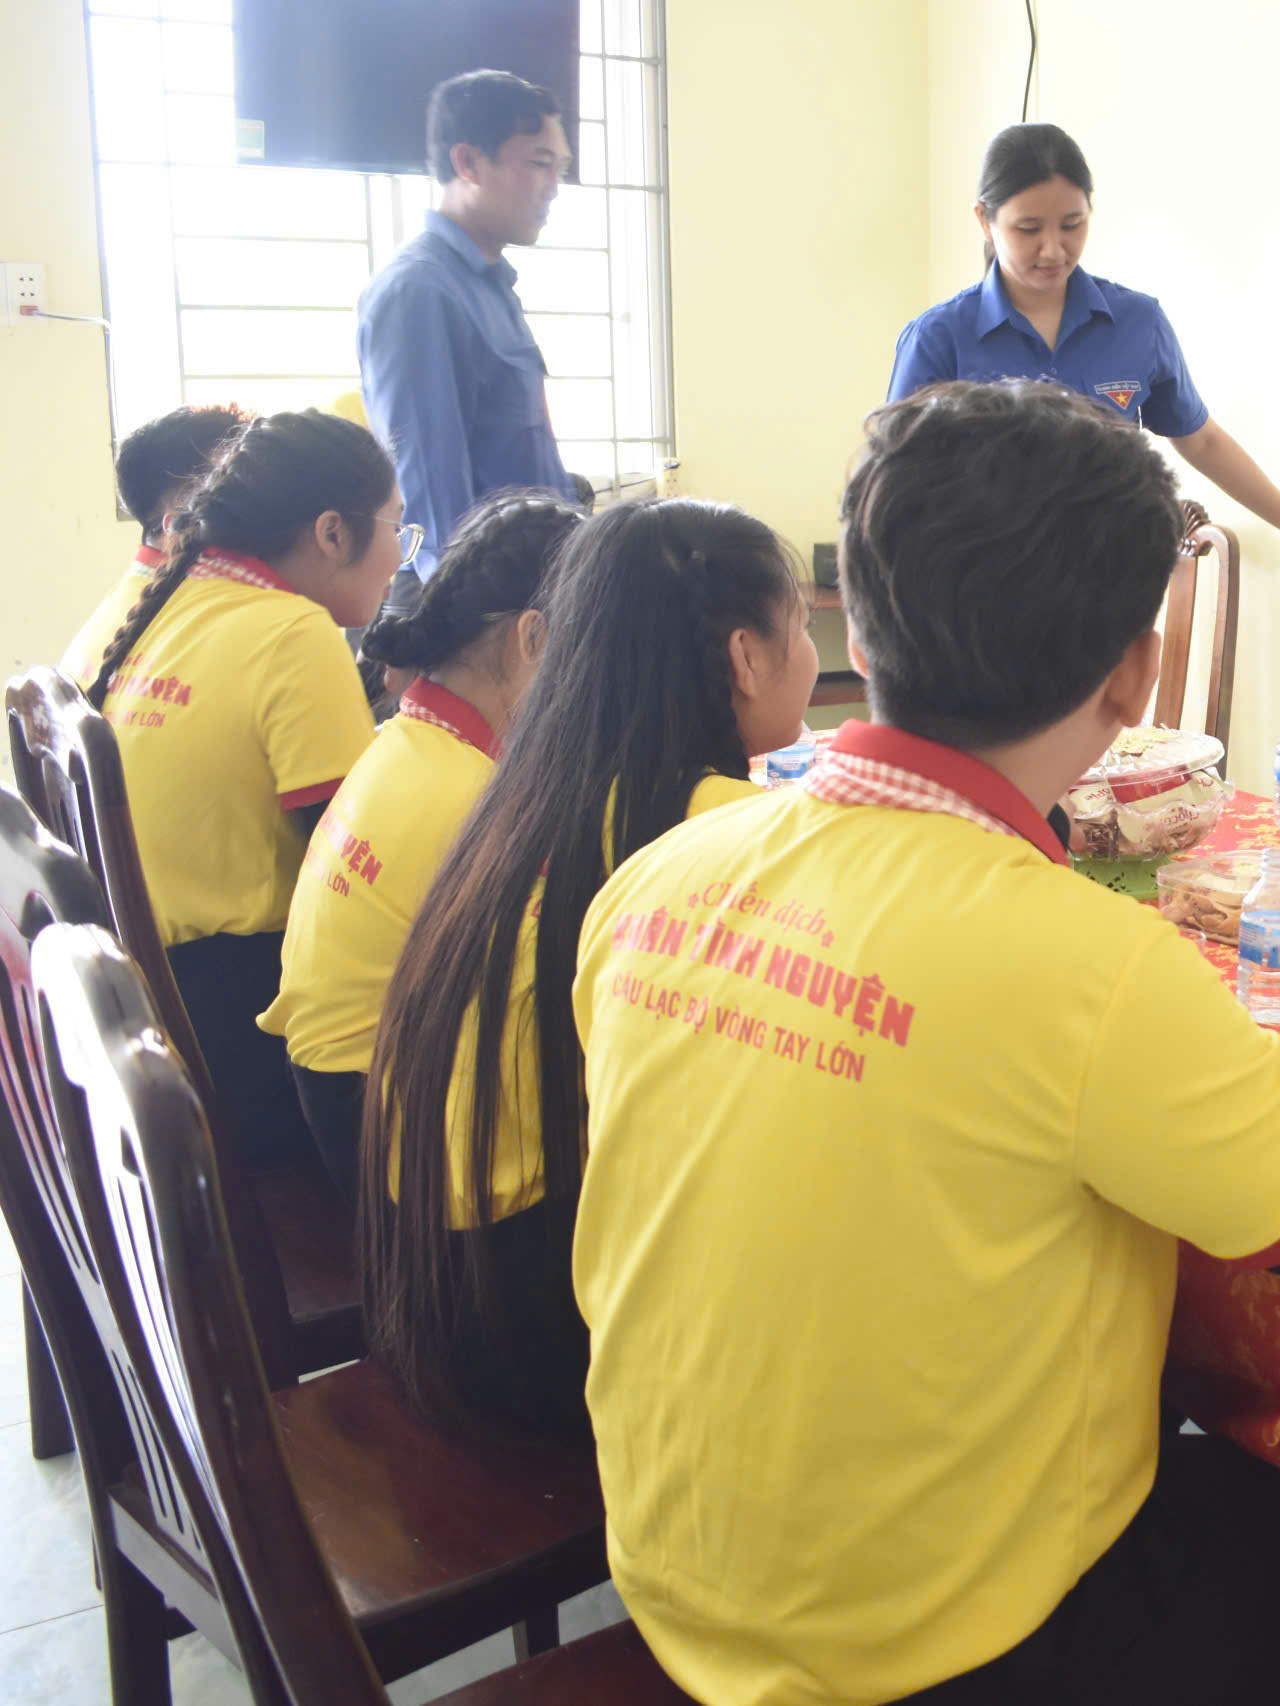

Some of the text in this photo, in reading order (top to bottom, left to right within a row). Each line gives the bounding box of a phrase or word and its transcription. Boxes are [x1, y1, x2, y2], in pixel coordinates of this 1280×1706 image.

[701, 880, 827, 938] Chiến dịch
[645, 981, 683, 1023] LẠC
[714, 1003, 769, 1050] VÒNG
[773, 1025, 813, 1064] TAY
[814, 1039, 866, 1084] LỚN
[690, 916, 767, 978] TÌNH
[763, 941, 916, 1049] NGUYỆN
